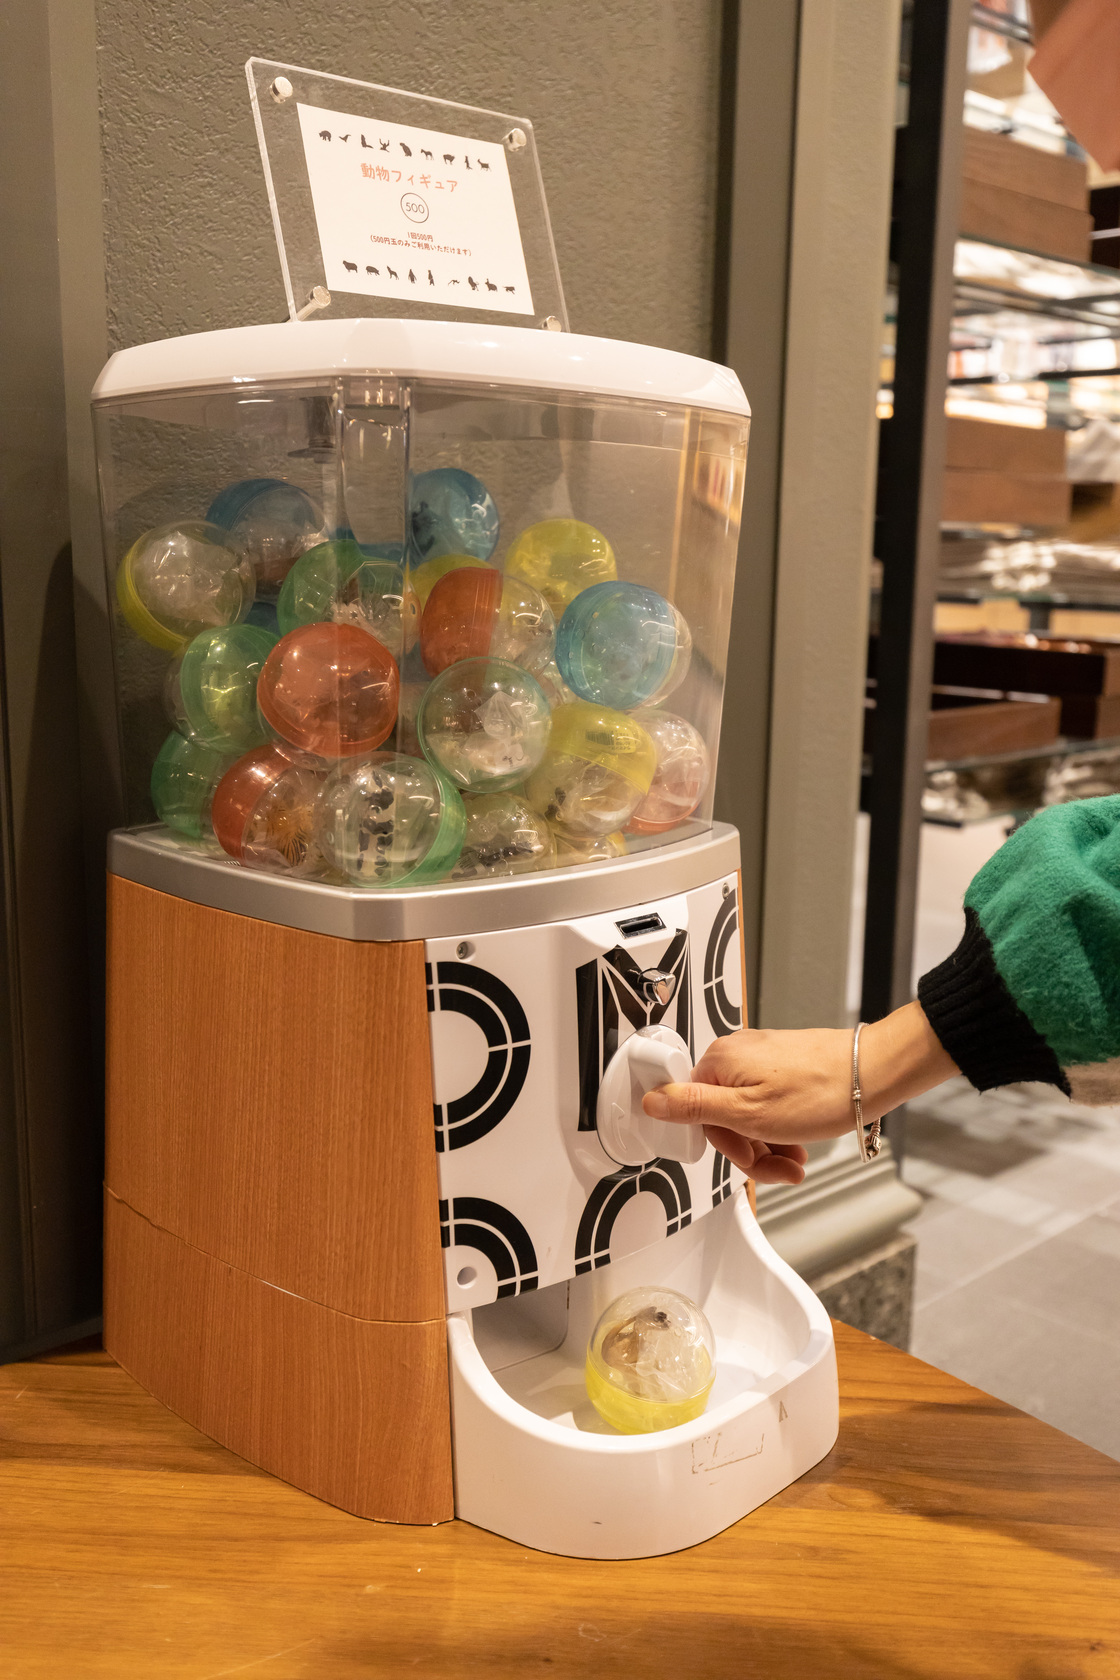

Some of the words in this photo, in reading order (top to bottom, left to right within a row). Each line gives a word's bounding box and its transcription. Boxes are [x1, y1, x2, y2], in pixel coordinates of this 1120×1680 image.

[360, 162, 458, 193] 動物フィギュア
[405, 201, 425, 214] 500
